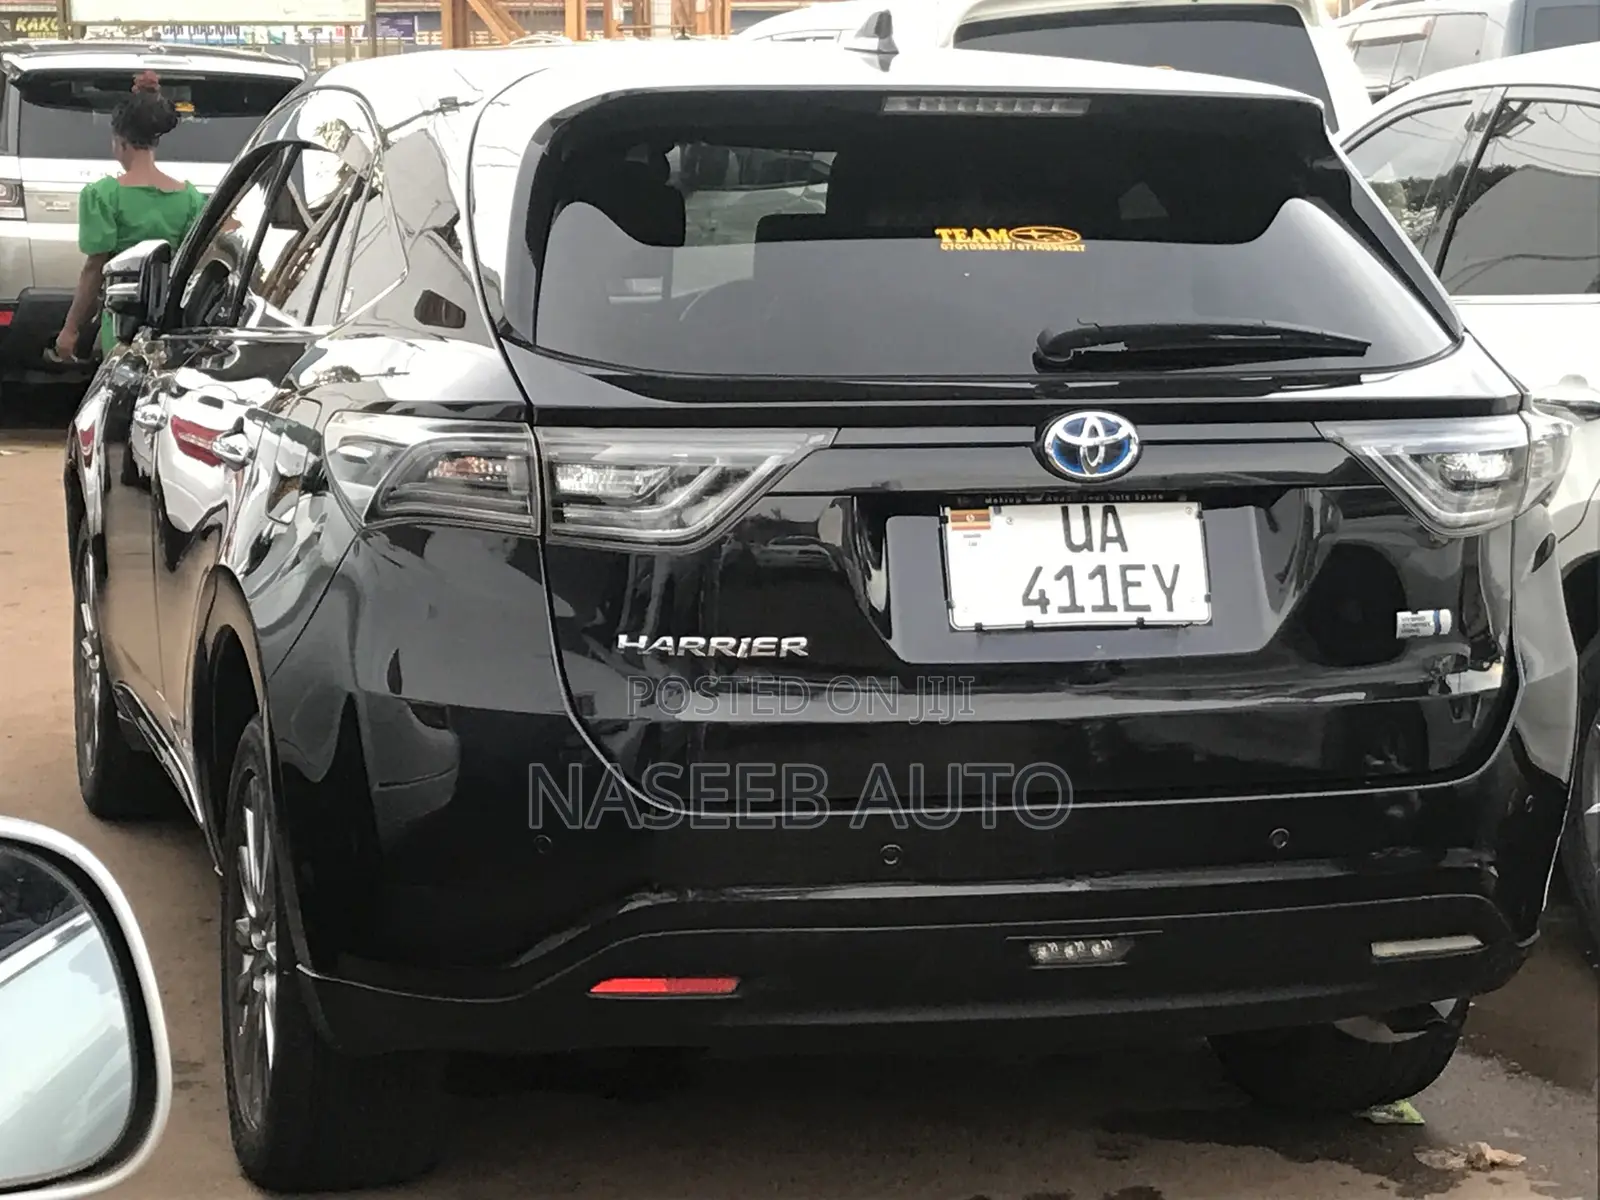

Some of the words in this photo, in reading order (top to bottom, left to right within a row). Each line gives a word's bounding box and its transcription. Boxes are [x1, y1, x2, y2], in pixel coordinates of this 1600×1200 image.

[935, 228, 1010, 243] TEAM
[1061, 505, 1128, 552] UA
[1022, 564, 1180, 614] 411EY
[617, 634, 809, 658] HARRIER
